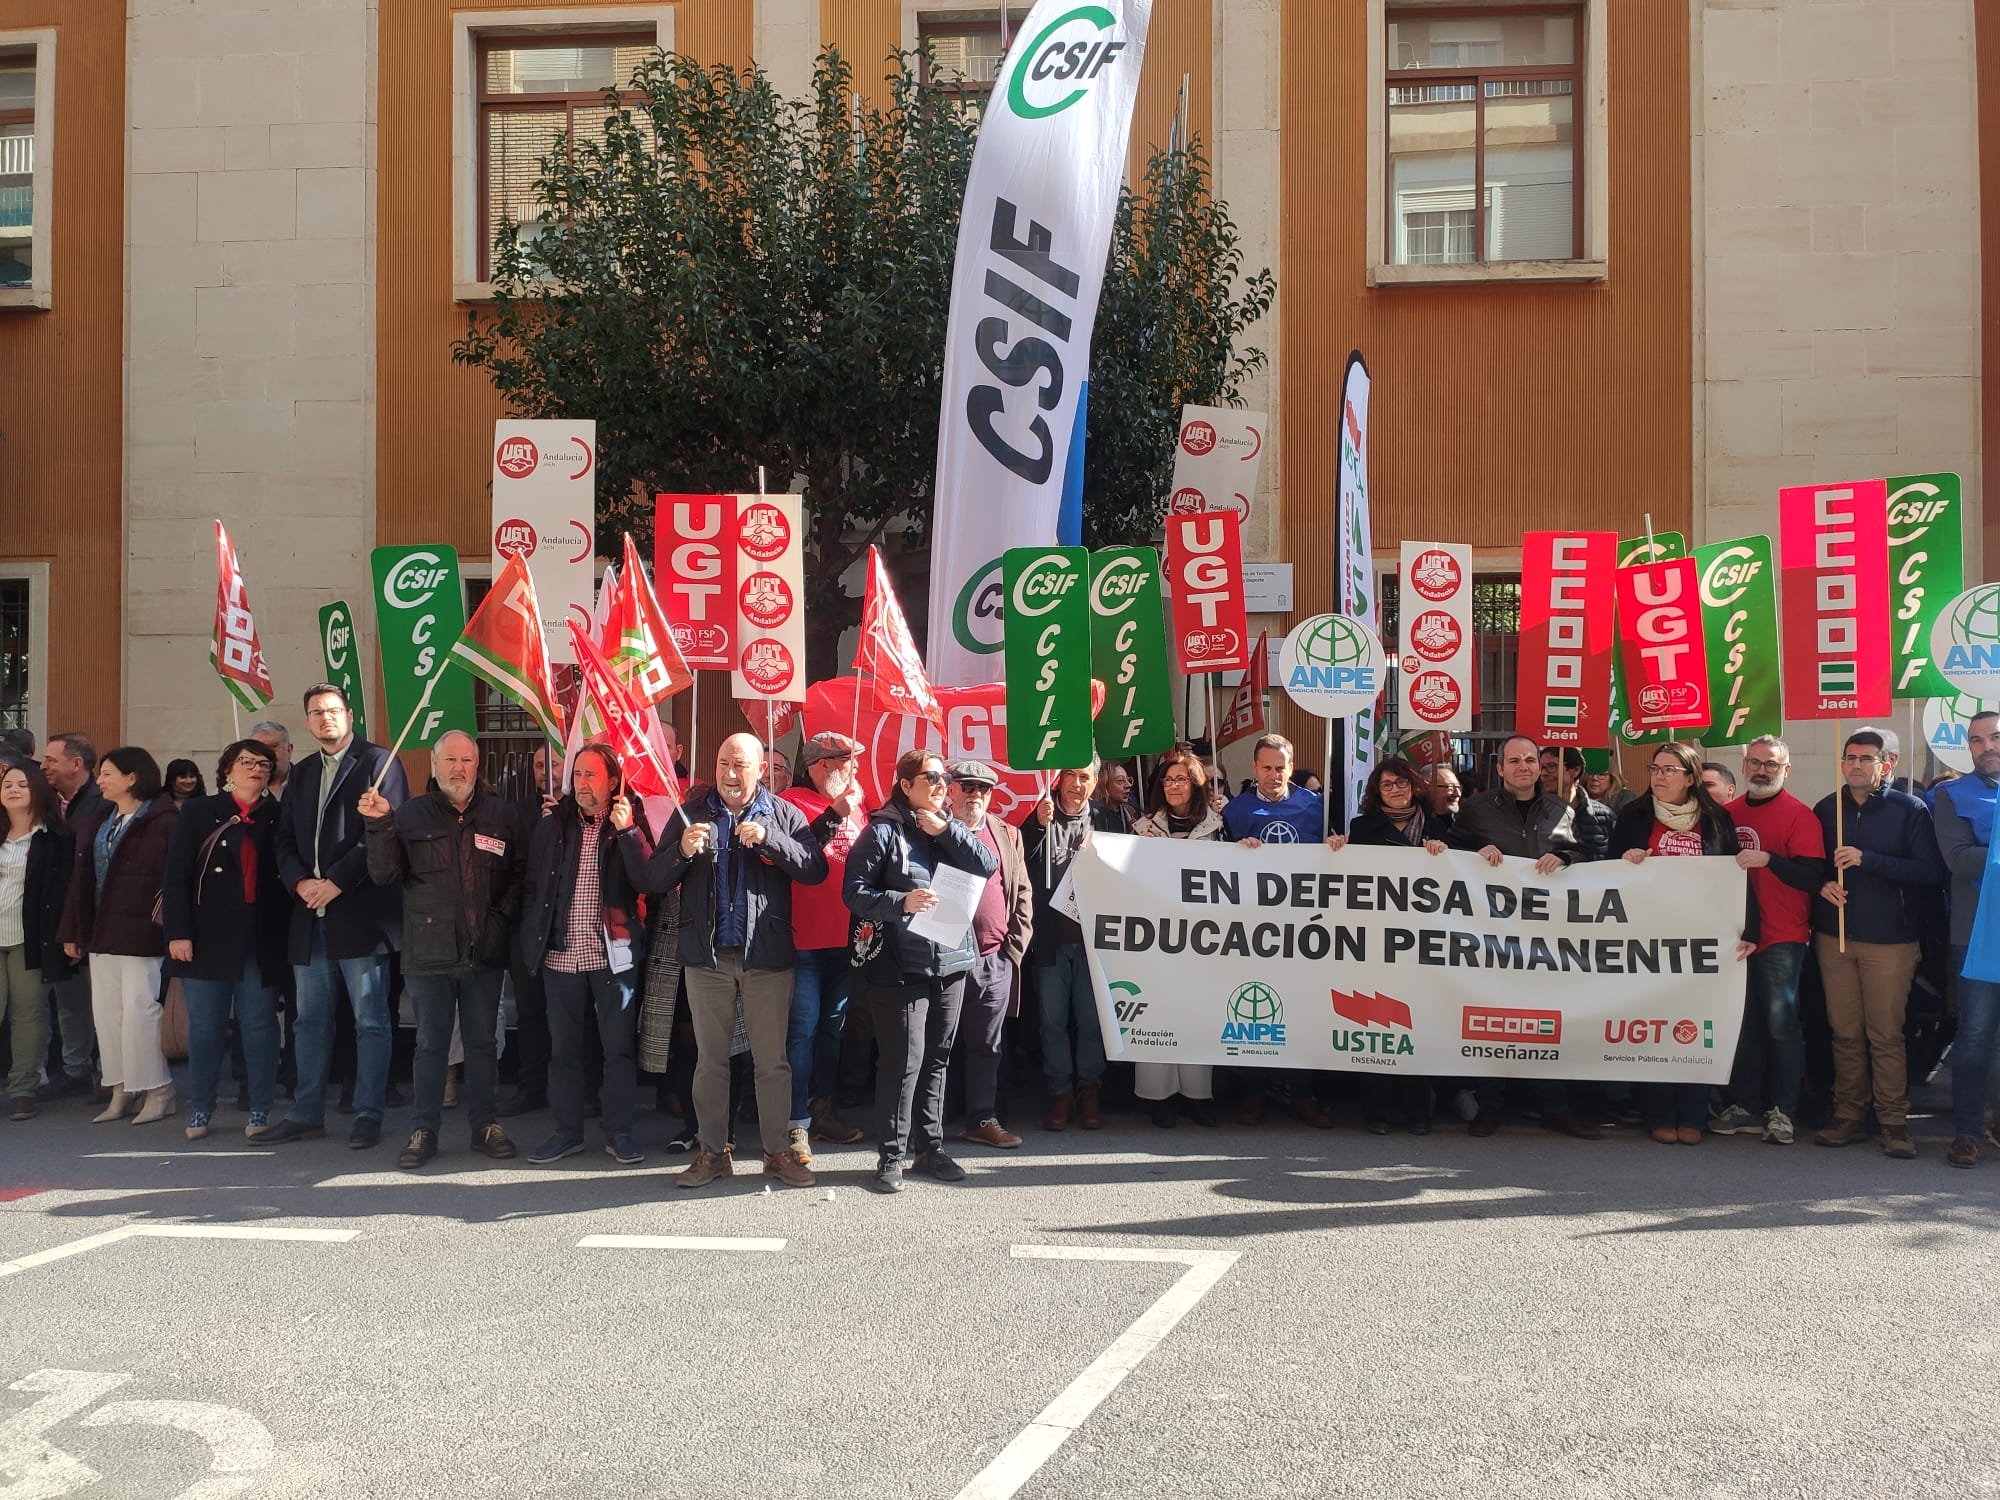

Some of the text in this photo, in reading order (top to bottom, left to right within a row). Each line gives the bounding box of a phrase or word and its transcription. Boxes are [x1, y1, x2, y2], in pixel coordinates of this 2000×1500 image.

[1031, 41, 1126, 82] CSIF
[966, 197, 1080, 486] CSIF
[1185, 426, 1212, 441] UGT
[1220, 436, 1254, 446] Andalucía
[502, 444, 533, 460] UGT
[543, 453, 583, 462] Andalucía
[1176, 492, 1202, 508] UGT
[747, 509, 778, 526] UGT
[1888, 500, 1949, 525] CSIF
[501, 526, 531, 544] UGT
[541, 537, 582, 545] Andalucía
[744, 544, 784, 558] Andalucía
[671, 503, 722, 621] UGT
[1421, 555, 1450, 571] UGT
[397, 568, 449, 590] CSIF
[1181, 518, 1231, 627] UGT
[1712, 561, 1763, 587] CSIF
[750, 577, 781, 595] UGT
[1026, 573, 1080, 596] CSIF
[1101, 572, 1150, 597] CSIF
[1417, 587, 1455, 598] Andalucía
[748, 611, 786, 625] Andalucía
[1421, 615, 1451, 632] UGT
[1633, 567, 1690, 682] UGT
[1897, 551, 1929, 690] CSIF
[330, 625, 350, 650] CSIF
[699, 630, 715, 639] FSP
[1188, 635, 1206, 647] UGT
[1211, 634, 1227, 643] FSP
[753, 643, 782, 660] UGT
[1417, 646, 1456, 659] Andalucía
[1943, 643, 2000, 669] AN
[411, 614, 445, 741] CSIF
[1289, 666, 1375, 689] ANPE
[1724, 610, 1751, 738] CSIF
[749, 678, 787, 690] Andalucía
[1036, 624, 1062, 761] CSIF
[1115, 620, 1145, 748] CSIF
[1420, 675, 1450, 692] UGT
[1643, 689, 1665, 702] UGT
[1671, 688, 1687, 697] FSP
[1818, 697, 1858, 710] Jaén
[1416, 707, 1455, 719] Andalucía
[1543, 728, 1578, 741] Jaén
[1931, 722, 1968, 745] AN
[1181, 869, 1628, 923] EN DEFENSA DE LA
[1094, 913, 1719, 974] EDUCACIÓN PERMANENTE
[1114, 1001, 1149, 1022] SIF
[1131, 1028, 1174, 1038] Educación
[1221, 1022, 1286, 1041] ANPE
[1469, 1015, 1537, 1035] CCOO
[1604, 1020, 1668, 1044] UGT
[1131, 1038, 1178, 1047] Andalucía
[1332, 1030, 1414, 1055] USTEA
[1351, 1055, 1397, 1066] ENSEÑANZA
[1461, 1045, 1559, 1060] enseñanza
[1603, 1054, 1713, 1065] Servicios Públicos Andalucía
